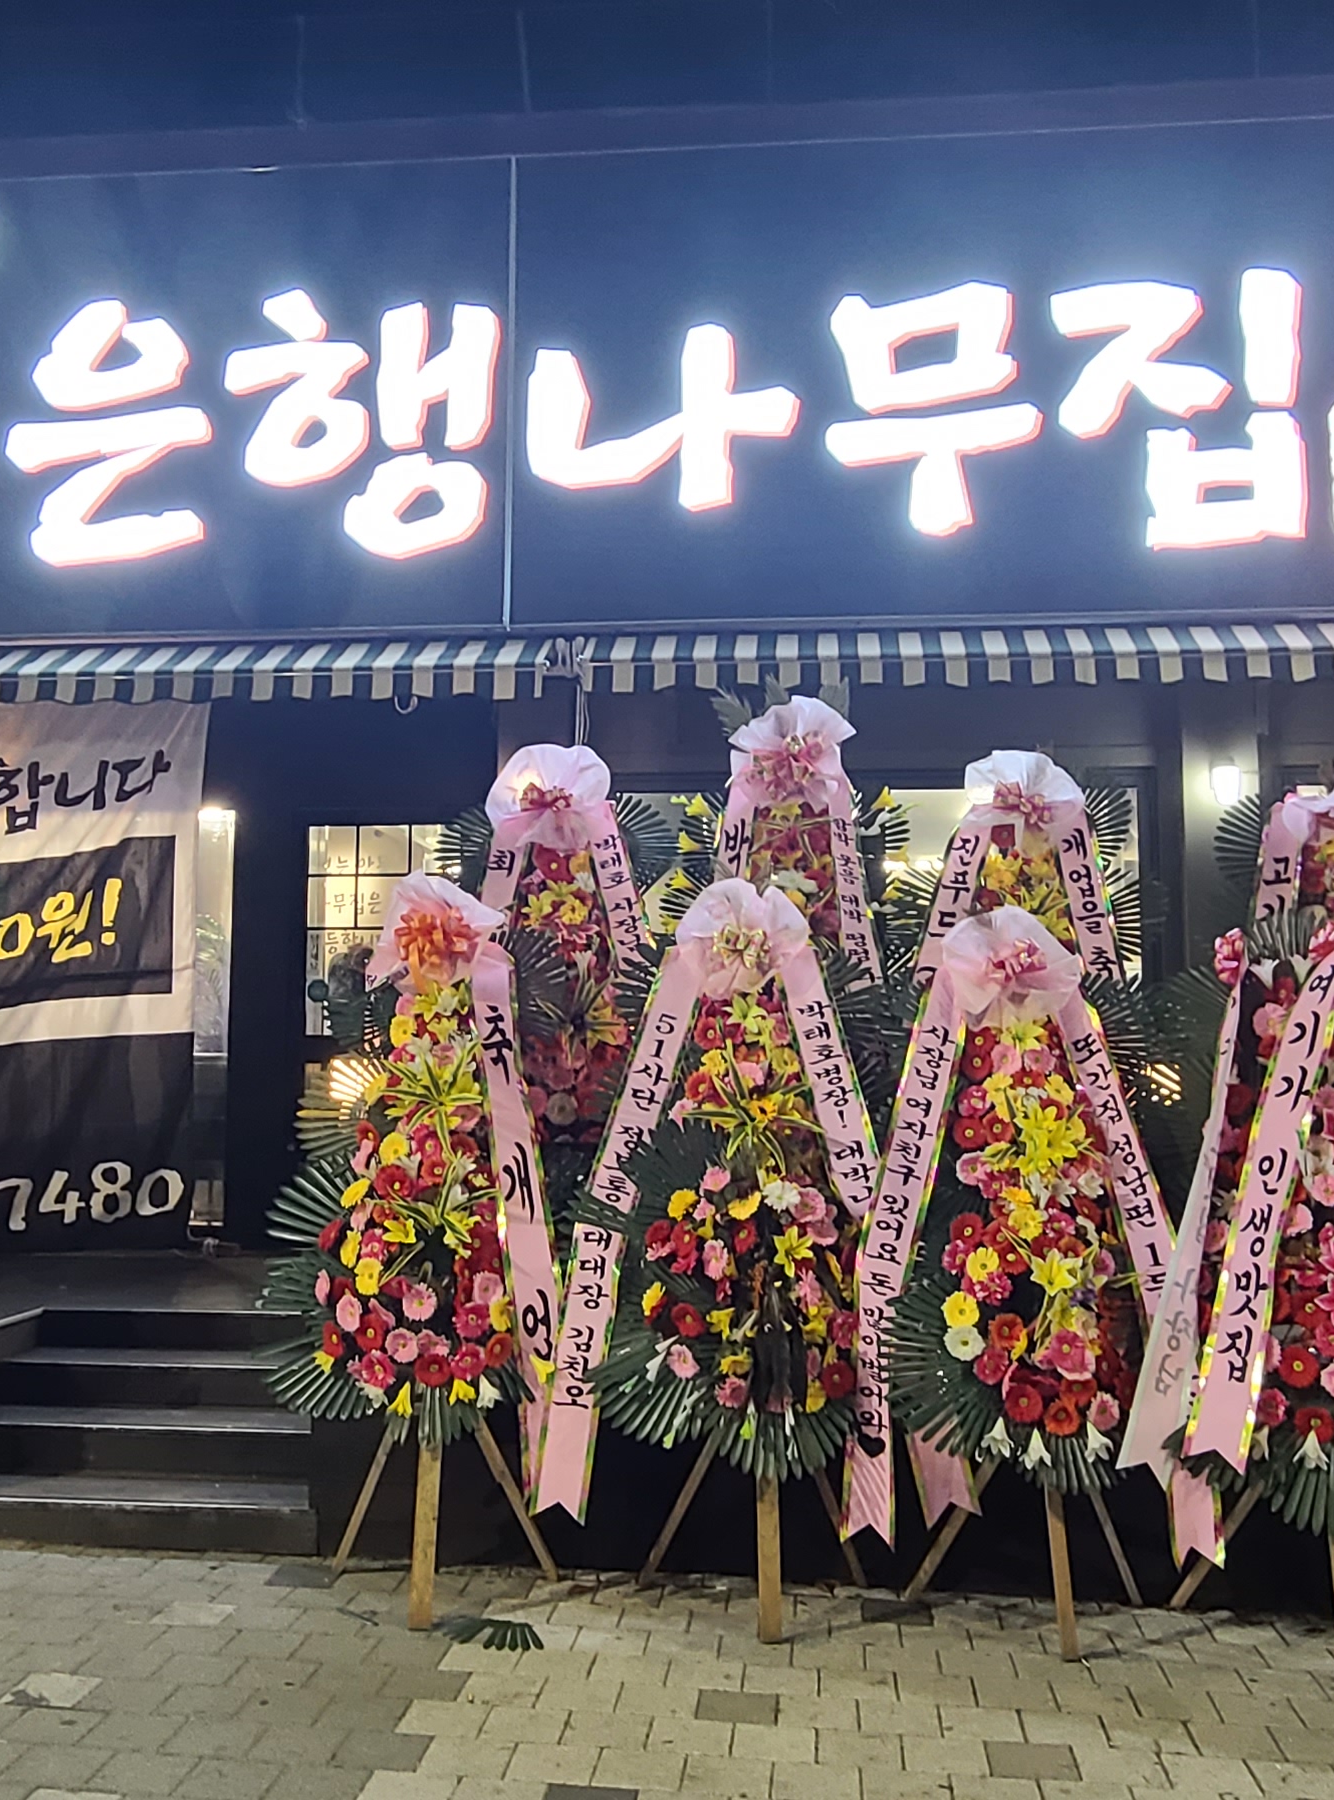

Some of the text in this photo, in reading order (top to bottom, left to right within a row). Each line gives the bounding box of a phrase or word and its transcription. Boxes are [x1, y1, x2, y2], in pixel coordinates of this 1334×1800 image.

[5, 266, 1308, 568] 은행나무집
[1061, 828, 1106, 935] 개업을
[915, 1023, 956, 1092] 사장님
[888, 1097, 935, 1187] 여자친구
[1067, 1032, 1124, 1125] 또간집
[1109, 1134, 1157, 1229] 성남편
[865, 1193, 913, 1268] 있어요
[1217, 1147, 1289, 1384] 인생맛집
[859, 1271, 898, 1298] 돈
